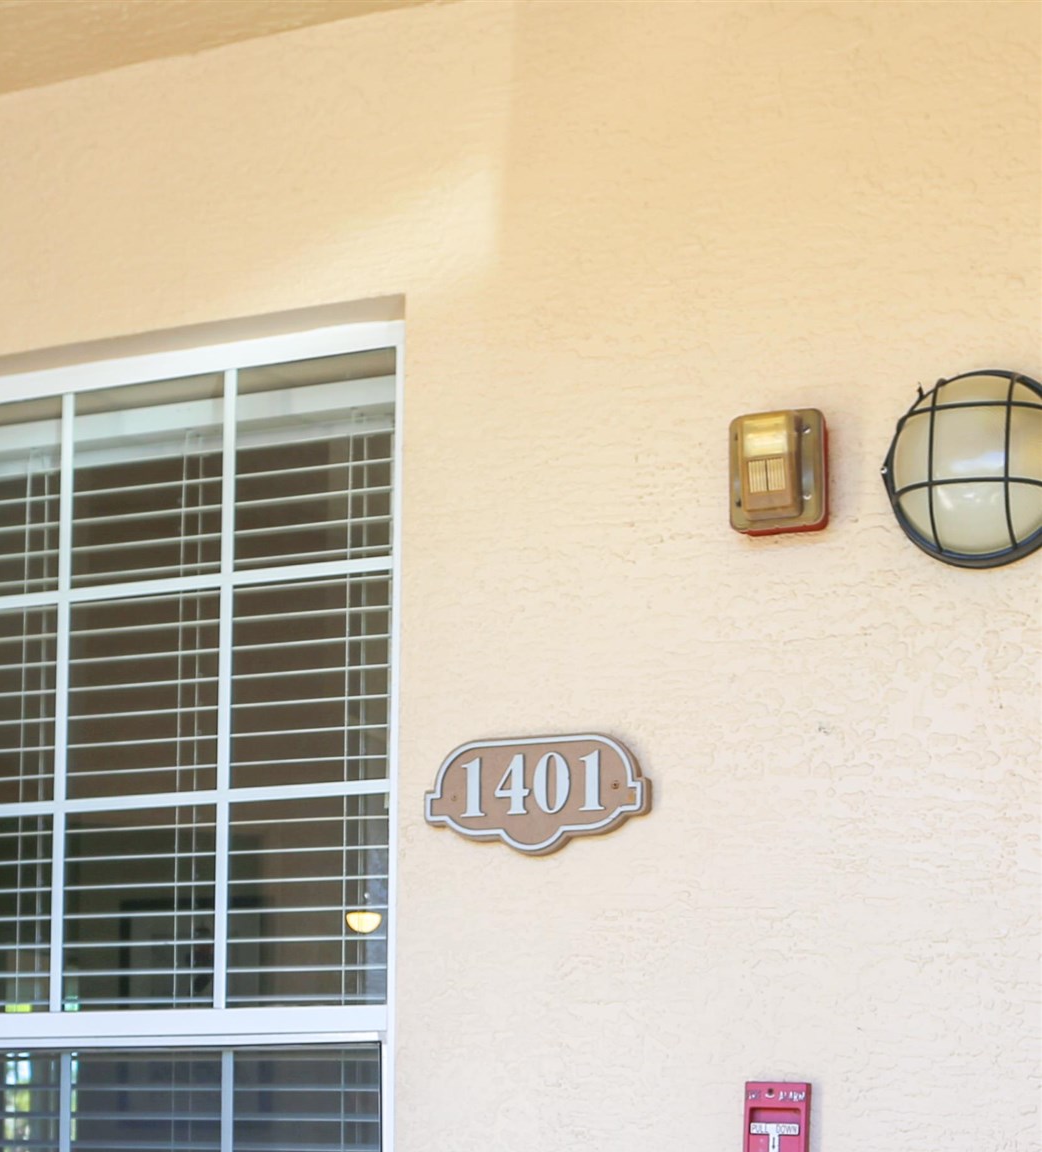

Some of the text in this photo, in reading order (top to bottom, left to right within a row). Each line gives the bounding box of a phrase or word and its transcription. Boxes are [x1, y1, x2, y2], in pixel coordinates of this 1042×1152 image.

[460, 749, 606, 818] 1401
[751, 1124, 798, 1135] PULL DOWN
